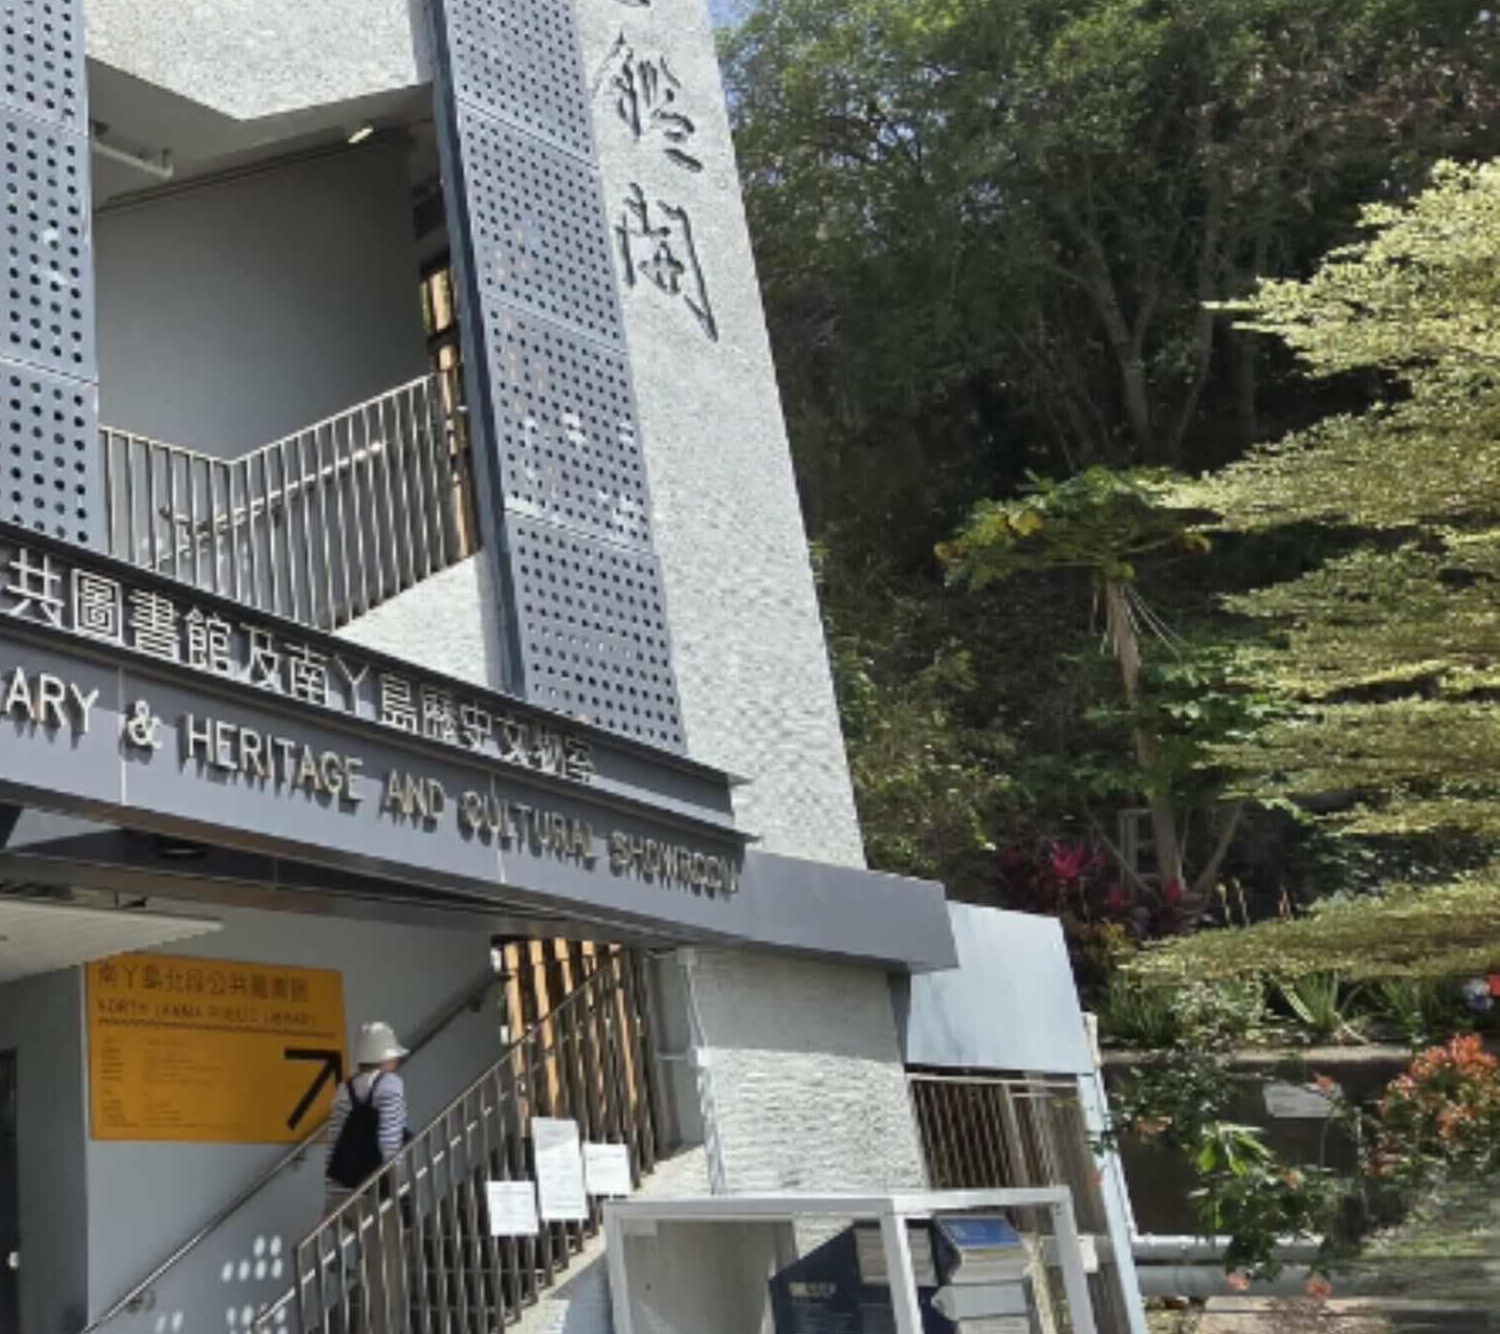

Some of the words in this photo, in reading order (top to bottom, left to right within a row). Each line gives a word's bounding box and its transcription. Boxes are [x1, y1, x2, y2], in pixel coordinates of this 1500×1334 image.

[126, 699, 164, 751] &
[186, 712, 365, 803] HERITAGE
[384, 773, 445, 822] AND
[460, 782, 598, 861] CULTURAL
[610, 829, 739, 894] SHOWROOM
